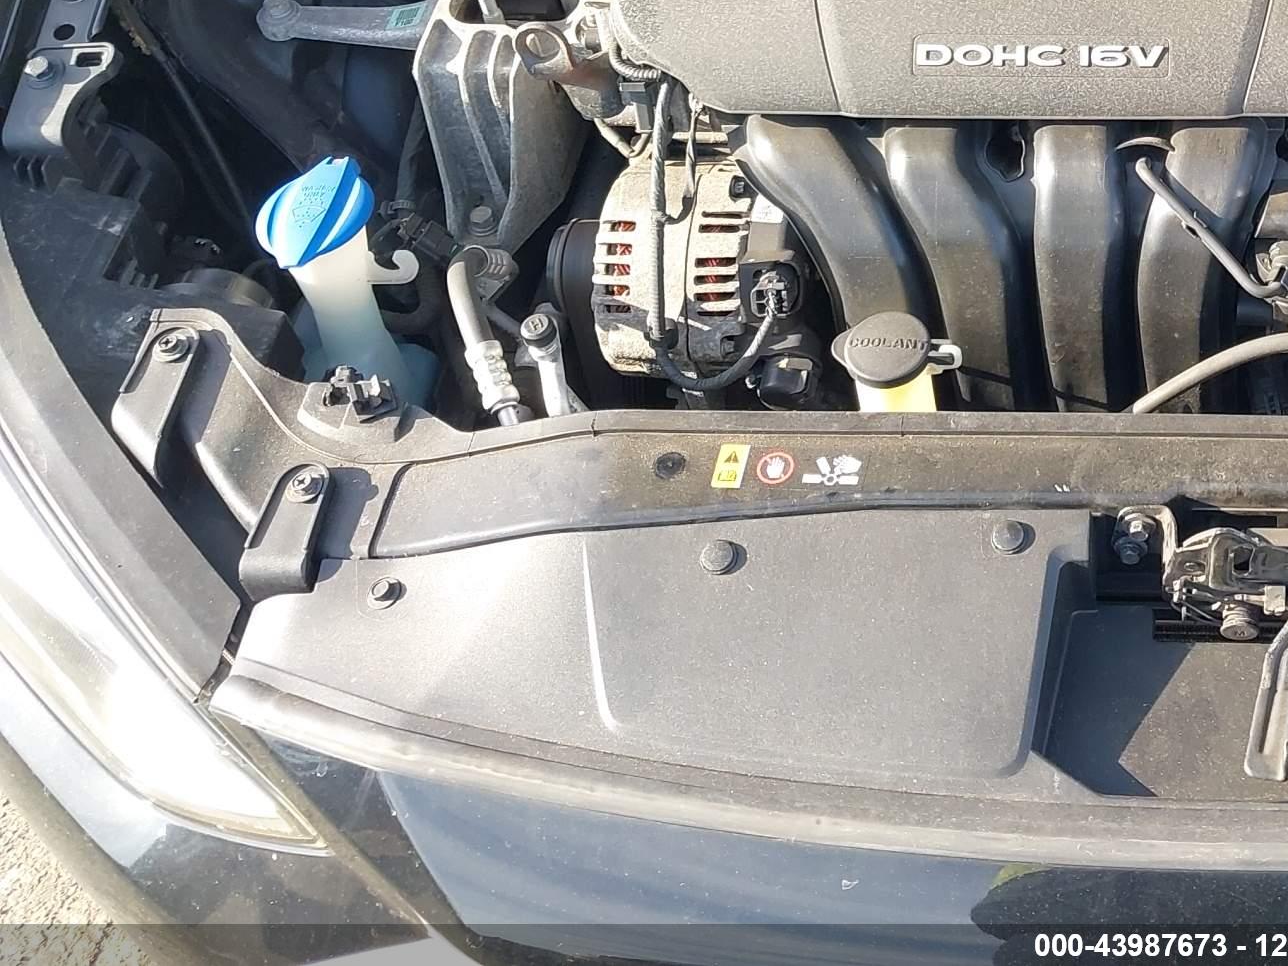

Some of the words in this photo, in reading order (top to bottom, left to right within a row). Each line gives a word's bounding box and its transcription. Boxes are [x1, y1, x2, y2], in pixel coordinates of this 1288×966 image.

[915, 43, 1067, 68] DOHC
[1078, 44, 1170, 69] 16V
[849, 337, 928, 353] COOLANT
